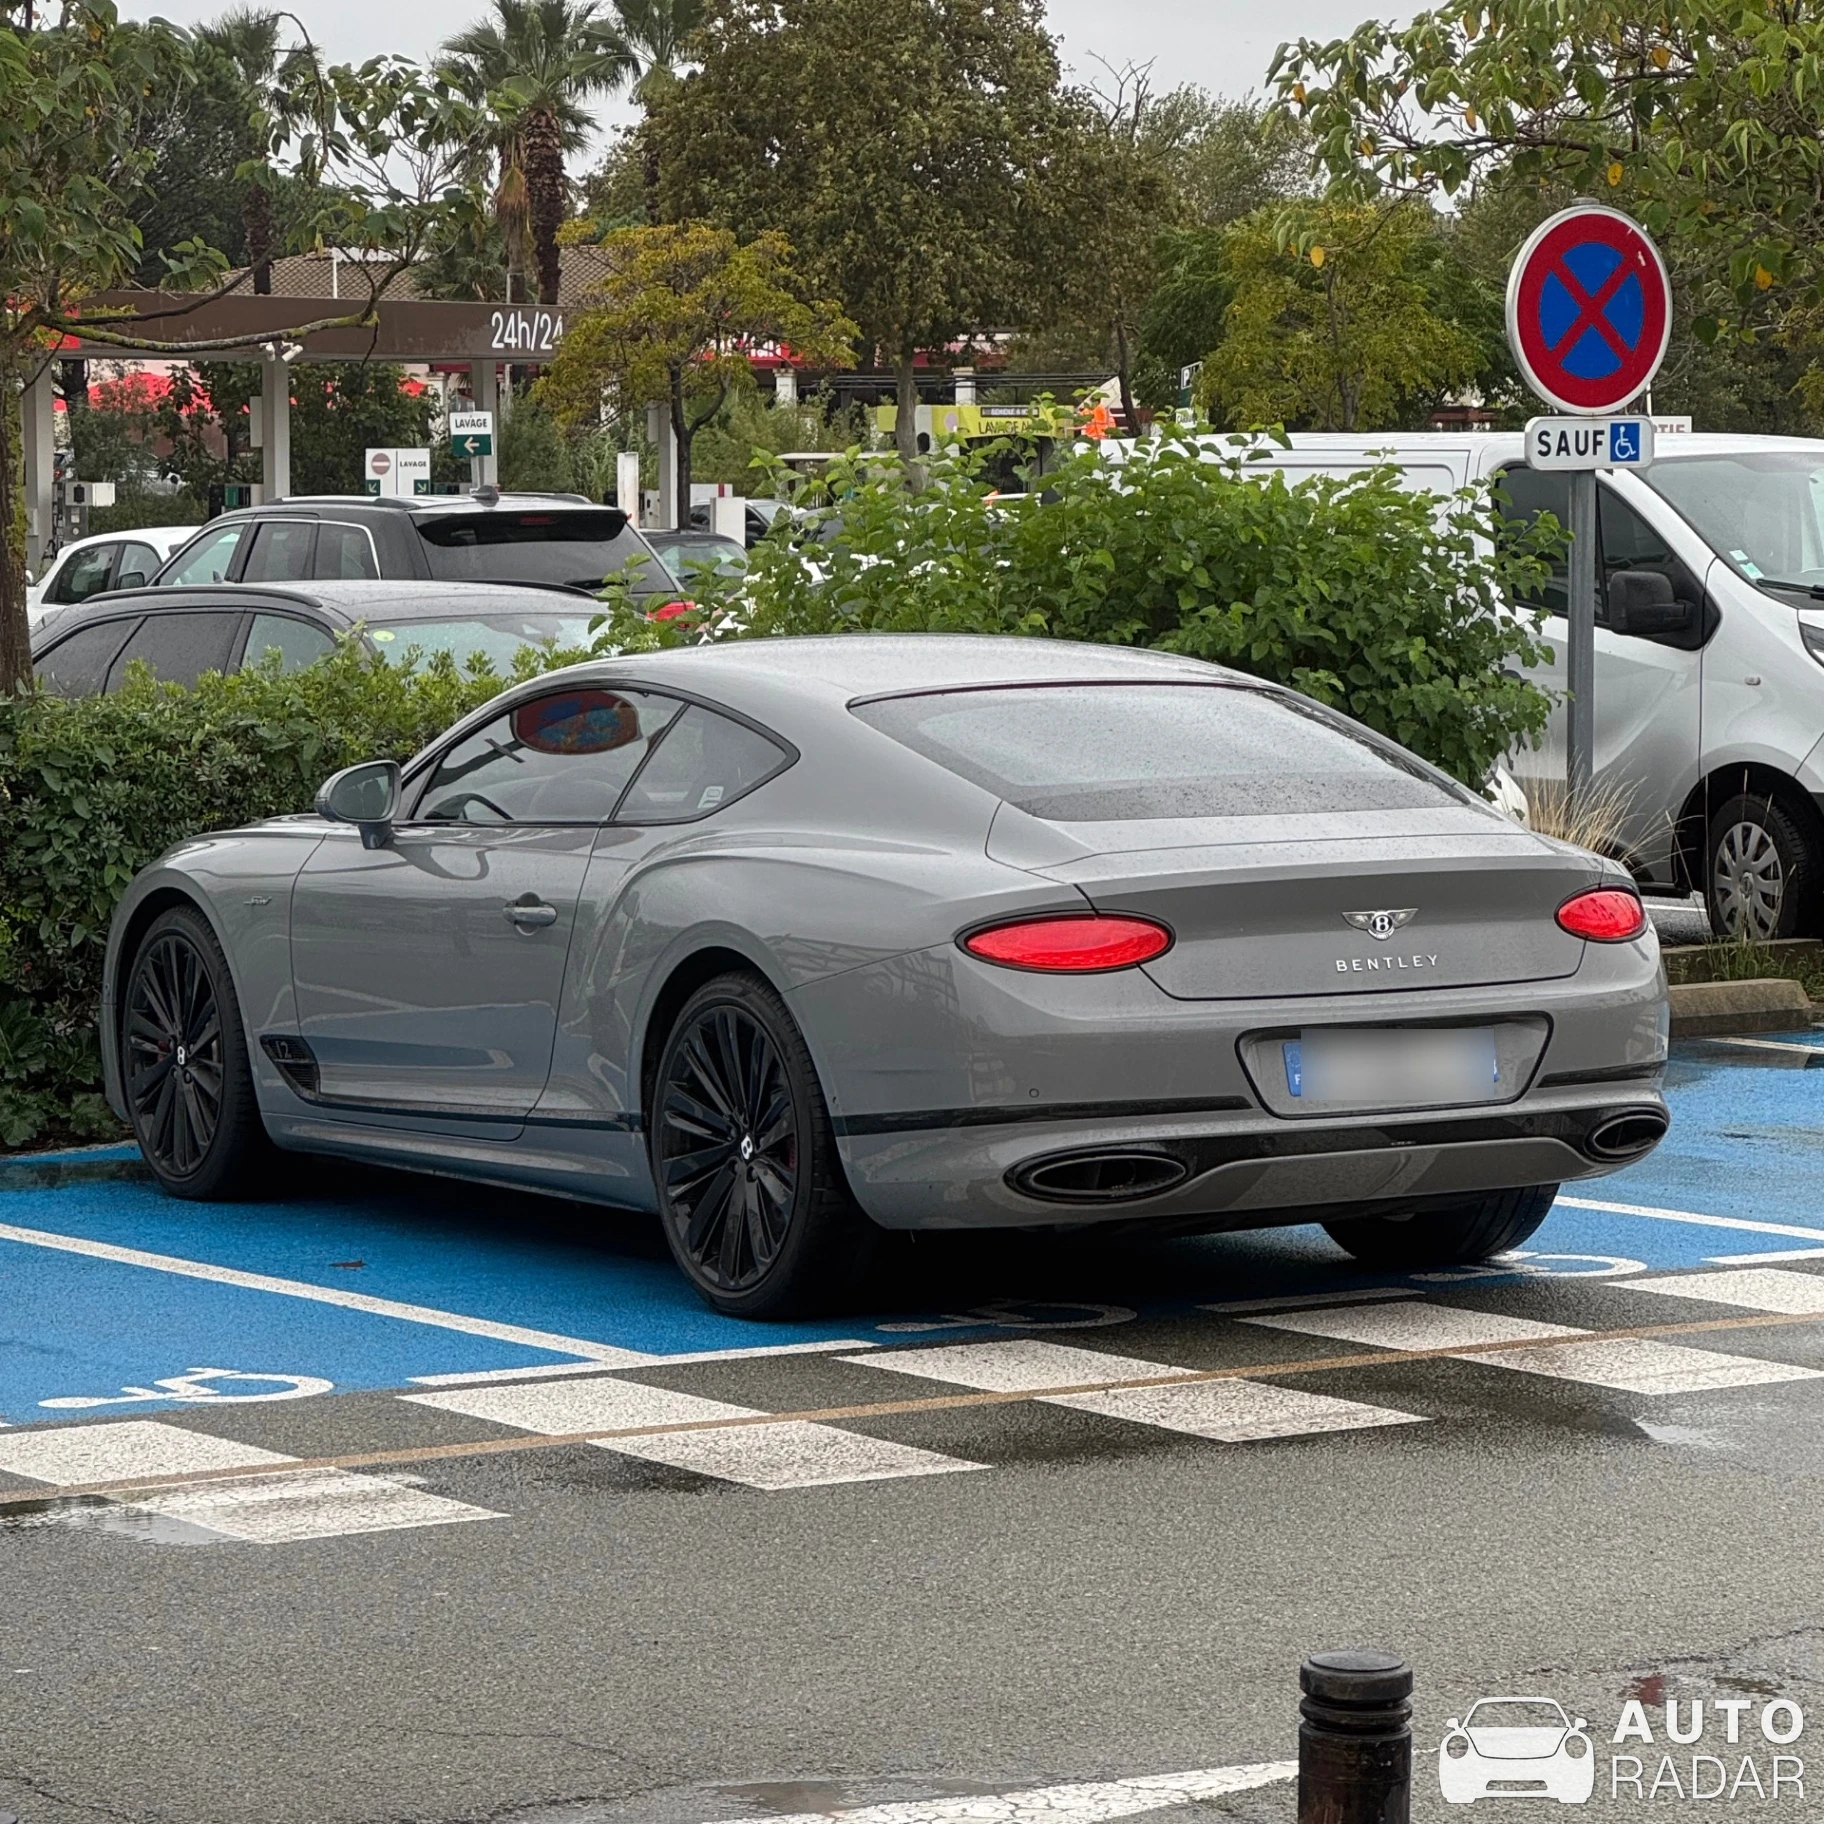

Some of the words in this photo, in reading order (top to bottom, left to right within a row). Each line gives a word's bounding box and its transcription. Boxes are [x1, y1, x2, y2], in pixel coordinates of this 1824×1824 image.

[491, 310, 563, 352] 24h/24
[454, 418, 488, 428] LAVAGE
[1537, 430, 1605, 457] SAUF
[1375, 915, 1390, 932] B
[1336, 955, 1437, 972] BENTLEY
